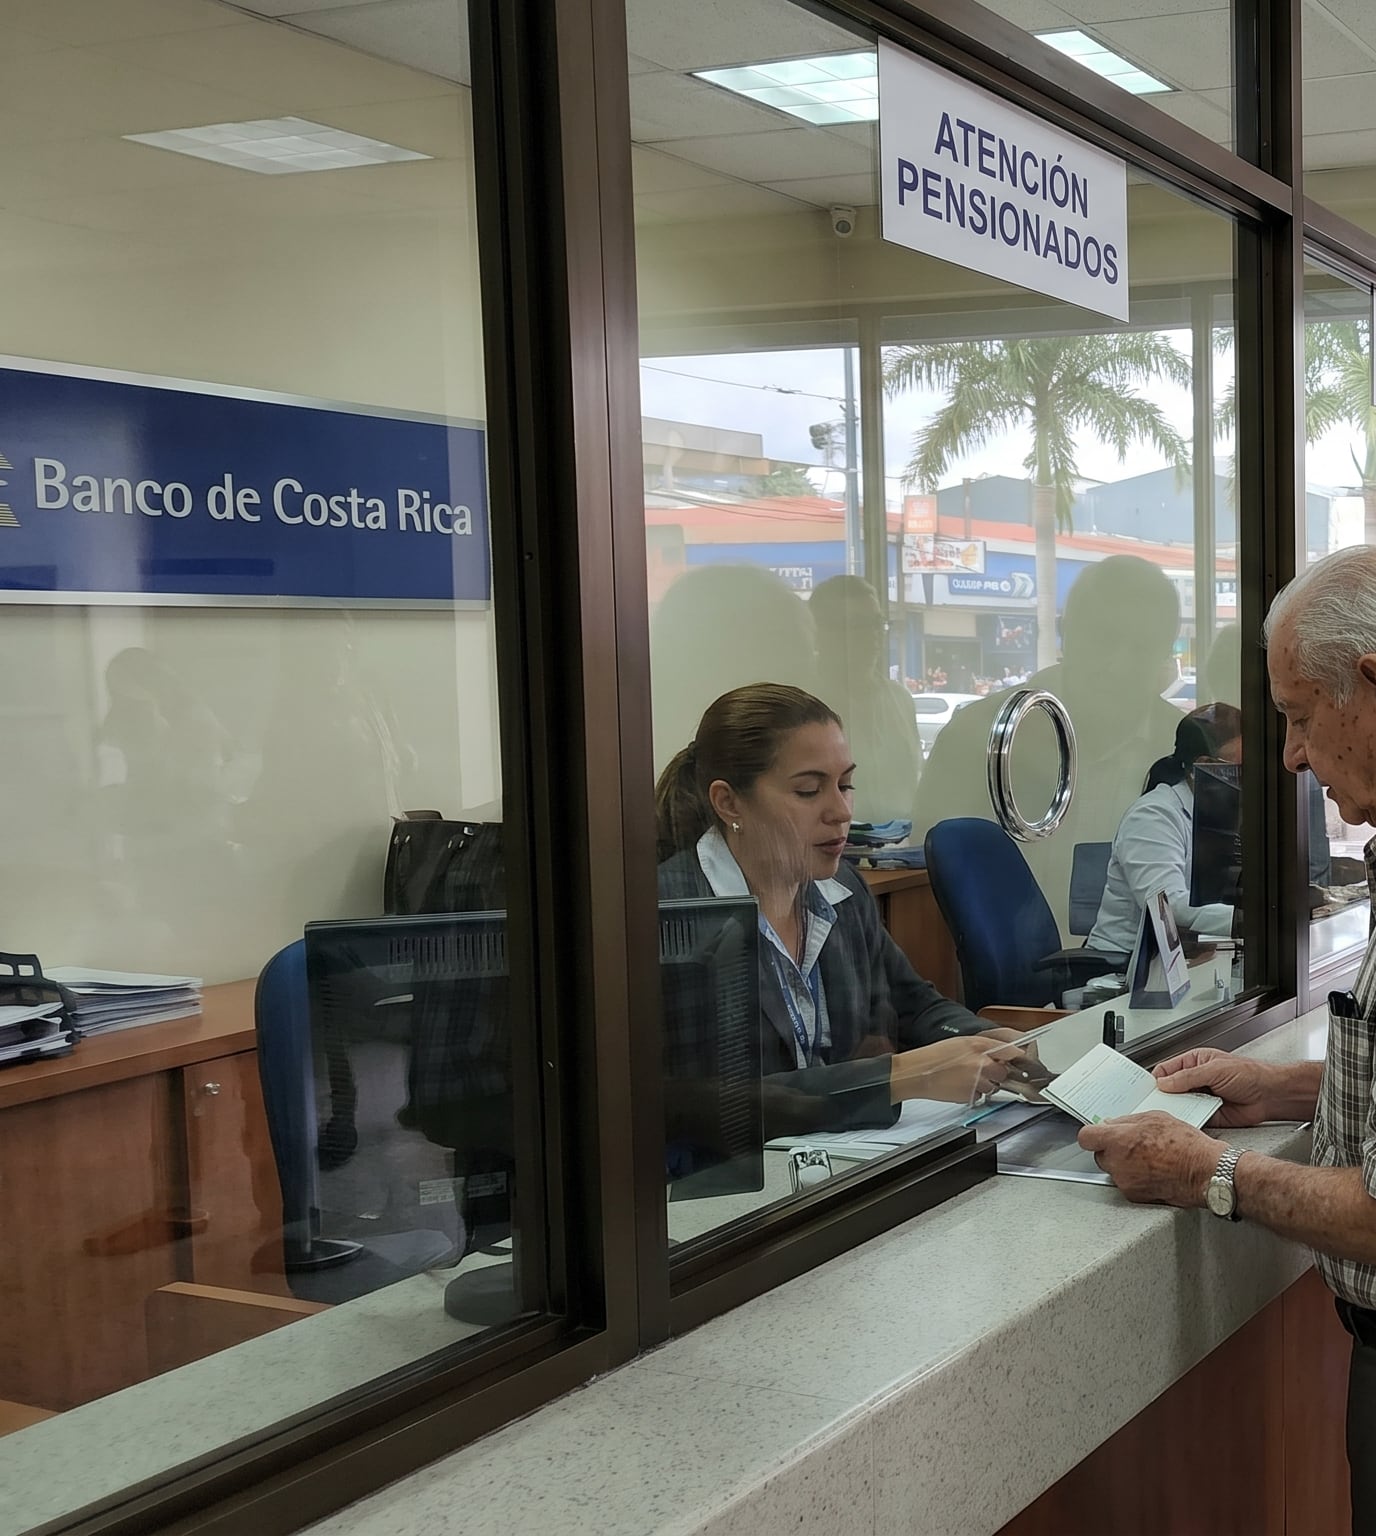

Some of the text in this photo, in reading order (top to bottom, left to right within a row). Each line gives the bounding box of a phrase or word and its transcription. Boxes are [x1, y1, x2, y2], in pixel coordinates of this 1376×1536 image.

[934, 111, 1088, 219] ATENCIÓN
[897, 157, 1119, 285] PENSIONADOS
[33, 457, 473, 536] Banco de Costa Rica
